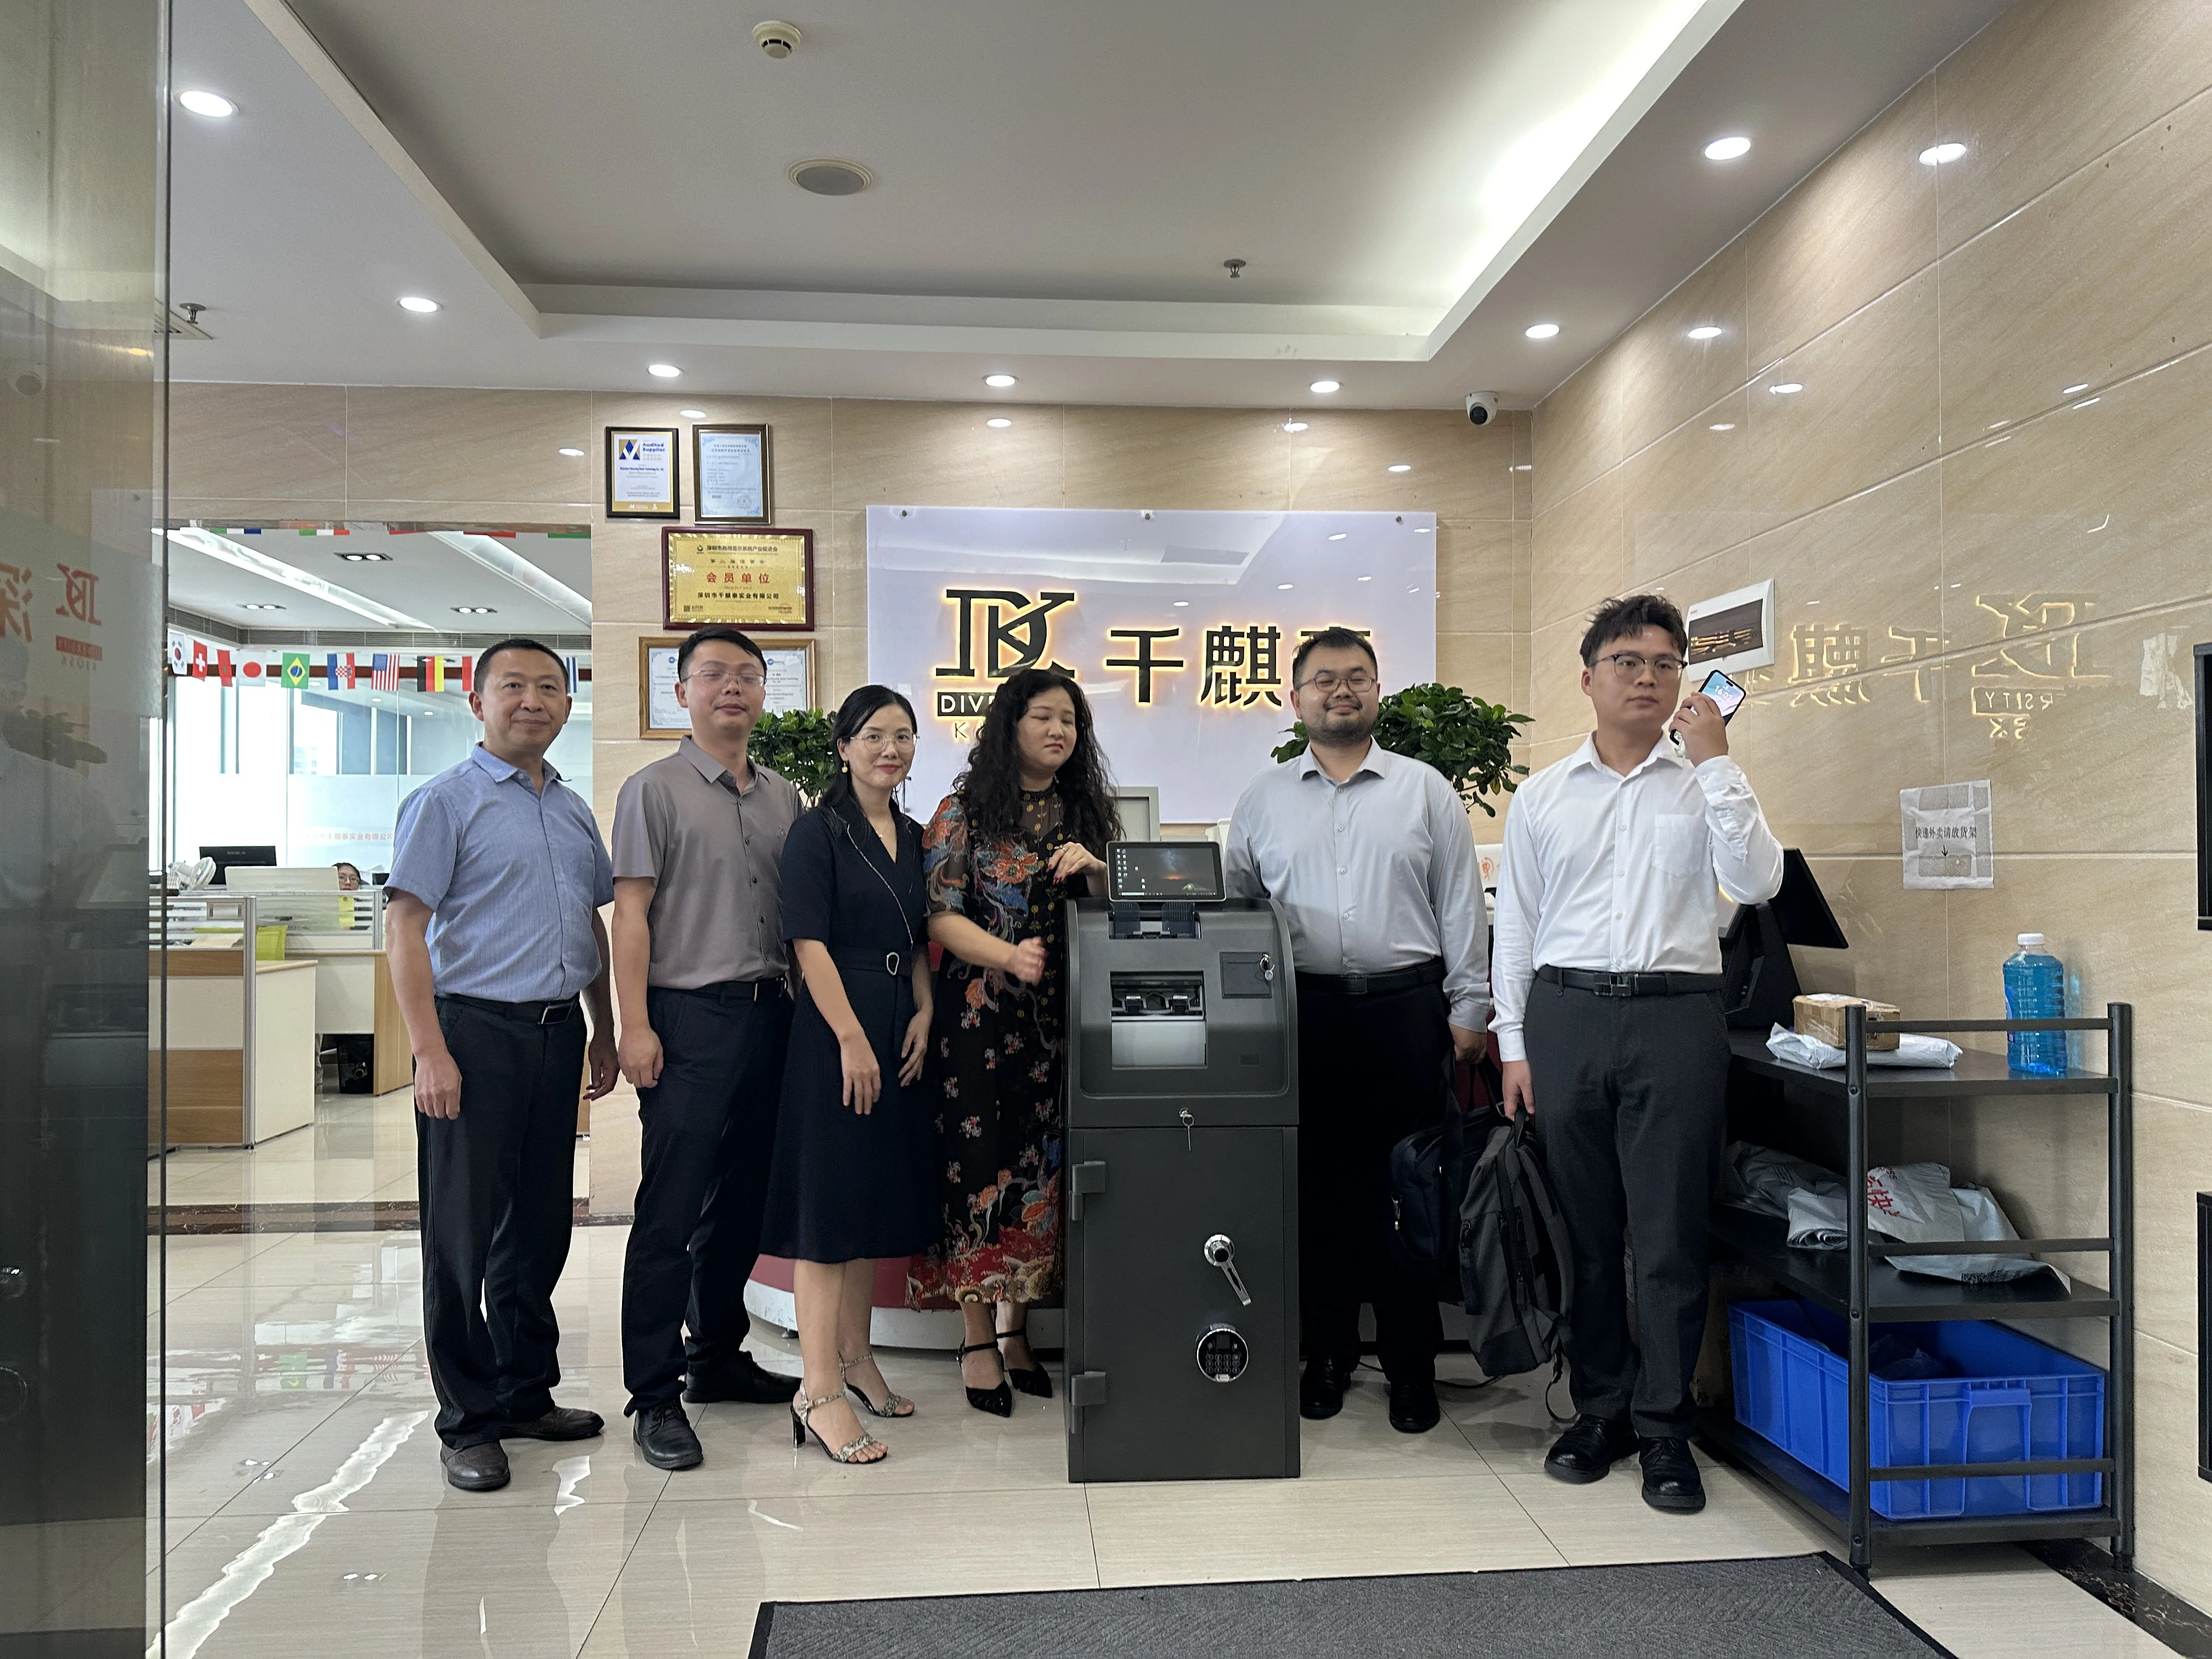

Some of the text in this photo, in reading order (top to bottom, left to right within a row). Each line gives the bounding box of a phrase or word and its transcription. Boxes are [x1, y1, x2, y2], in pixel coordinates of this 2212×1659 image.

[707, 572, 770, 584] 会员单位
[1106, 625, 1371, 707] 千麒
[1714, 685, 1733, 703] 16:02
[1915, 826, 1978, 839] 快递外卖请放货架
